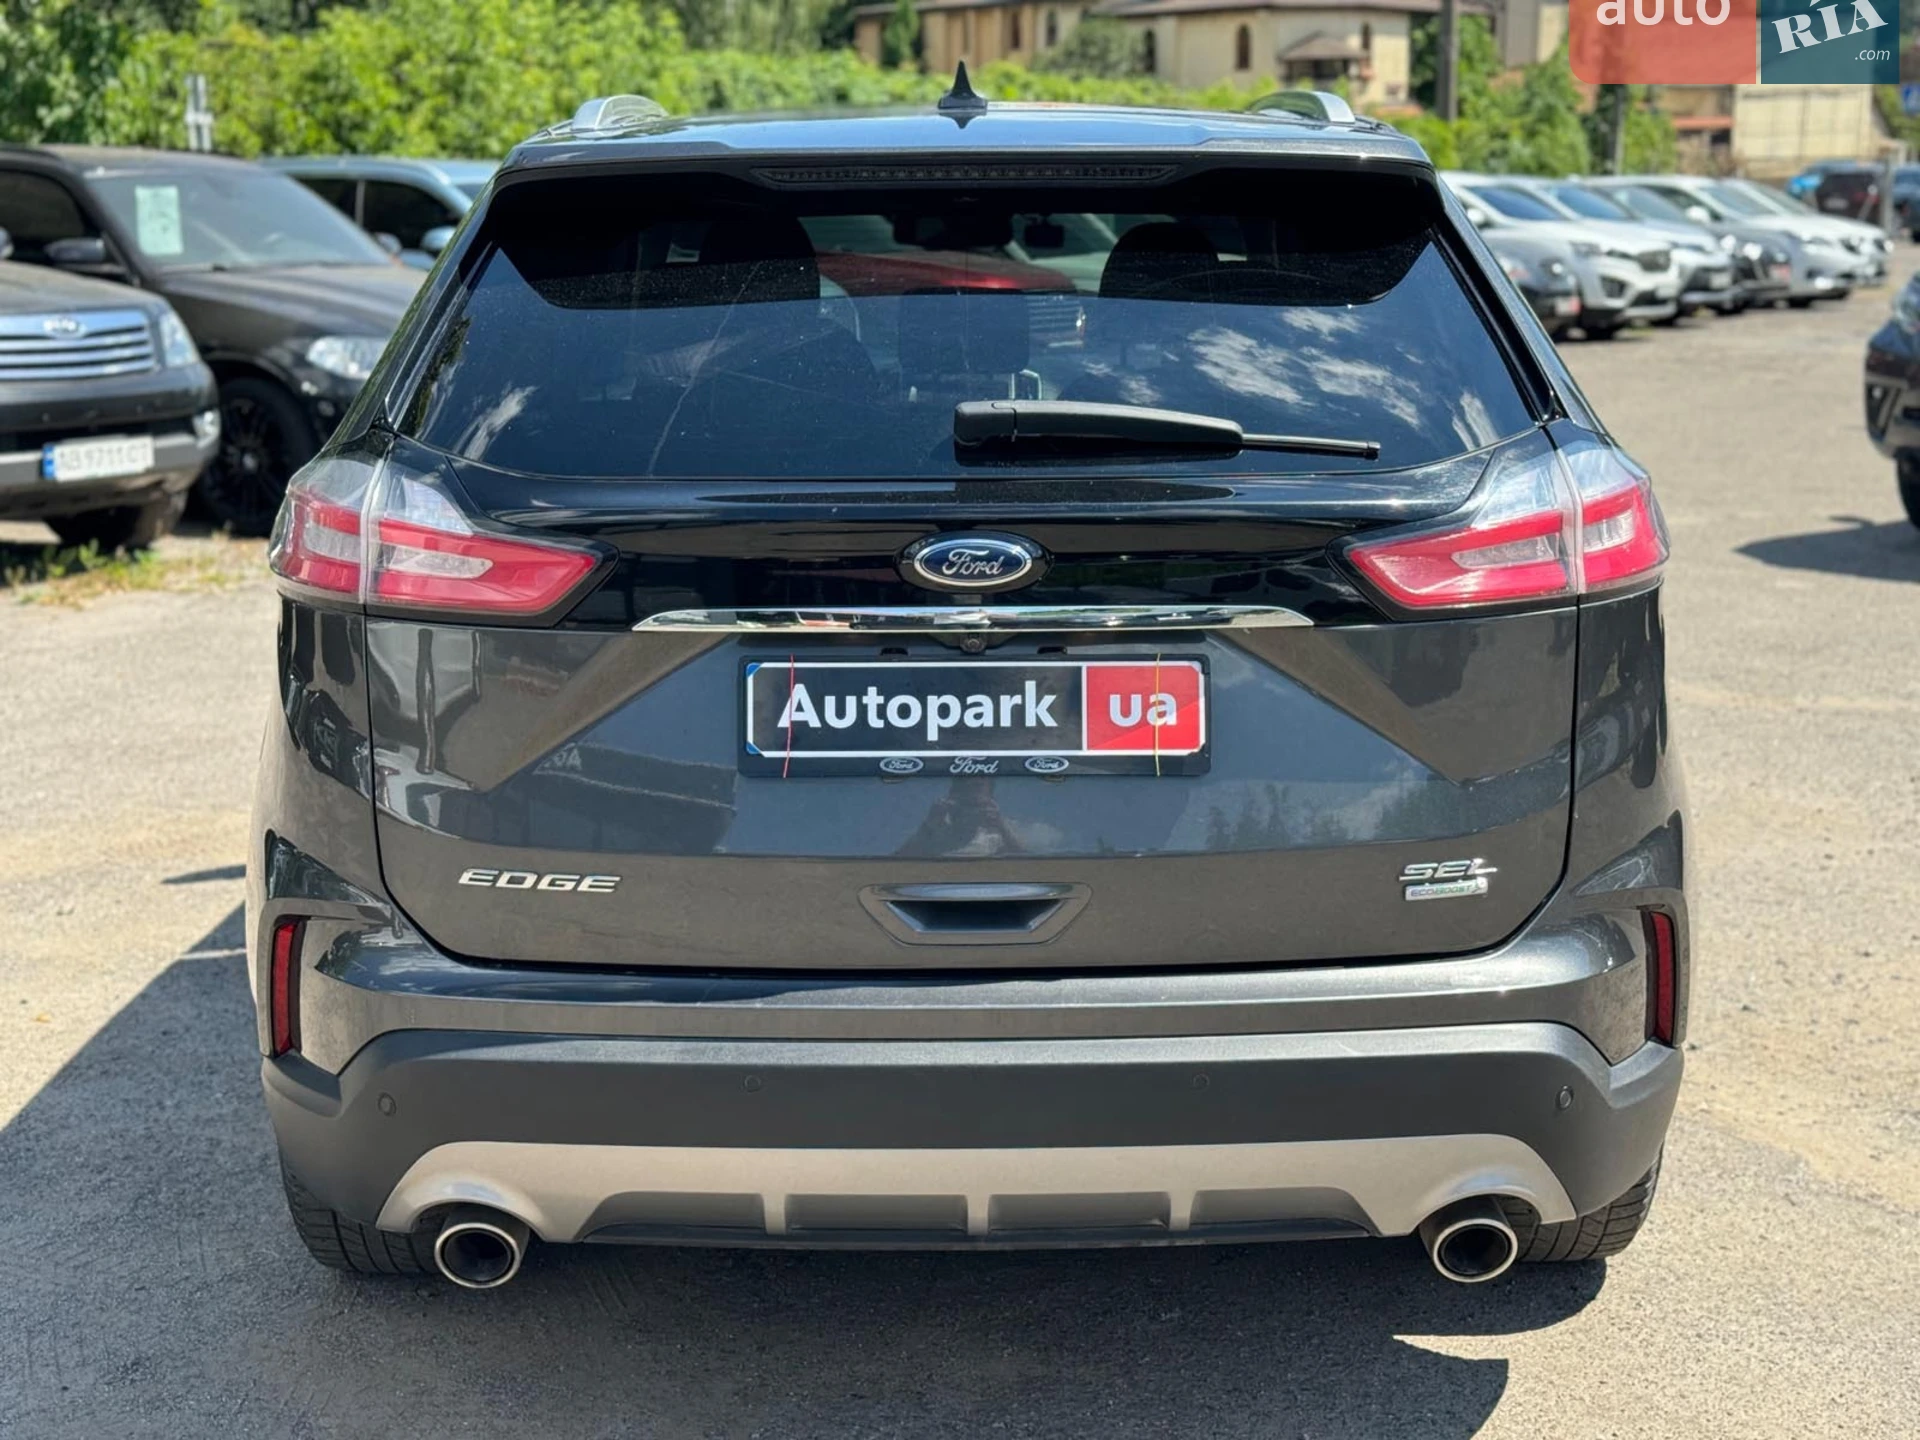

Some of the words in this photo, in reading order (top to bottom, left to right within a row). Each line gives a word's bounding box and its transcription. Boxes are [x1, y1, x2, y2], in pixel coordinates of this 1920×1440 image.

[942, 548, 1004, 575] Ford
[777, 680, 1058, 741] Autopark
[1109, 691, 1178, 727] ua
[949, 755, 999, 774] Ford
[458, 868, 622, 893] EDGE
[1399, 858, 1498, 881] SEL
